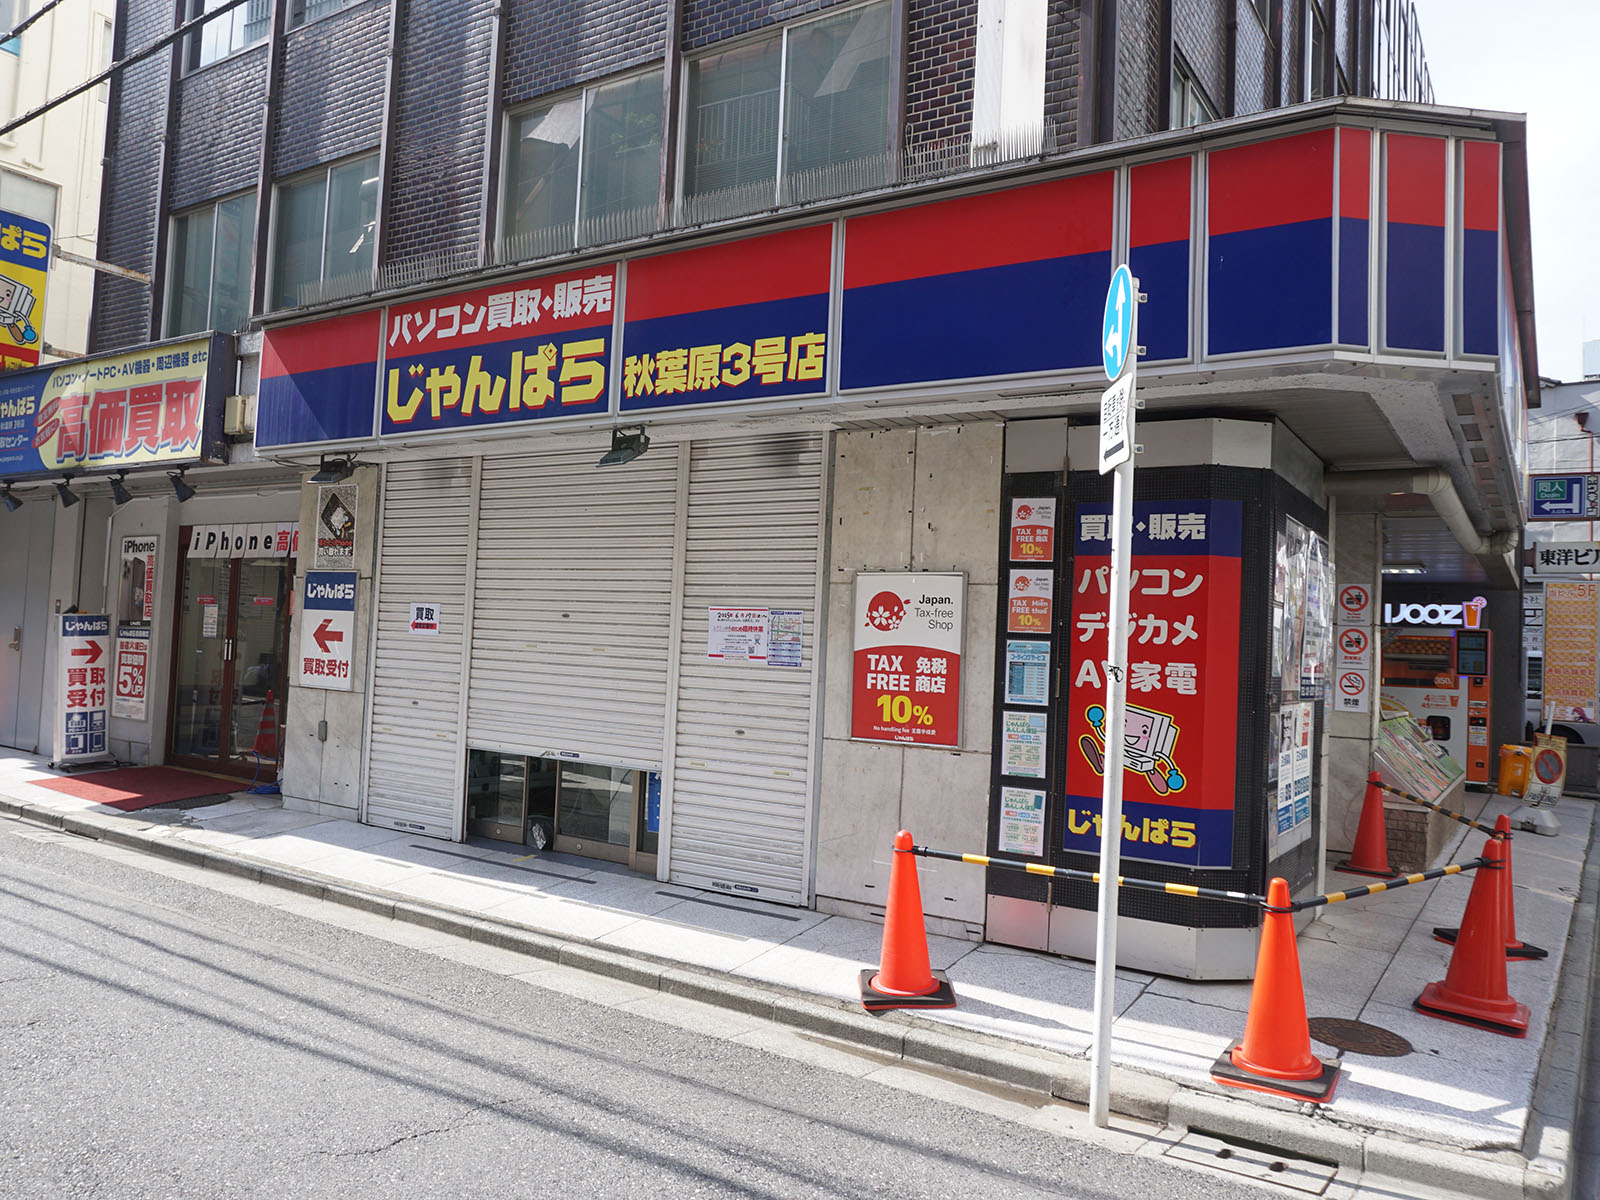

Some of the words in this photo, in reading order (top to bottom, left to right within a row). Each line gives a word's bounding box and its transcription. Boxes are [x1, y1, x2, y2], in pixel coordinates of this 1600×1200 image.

[192, 350, 208, 364] etc
[623, 332, 827, 397] 秋葉原3号店
[385, 337, 605, 423] じゃんぱら
[56, 378, 203, 464] 高価買取
[1016, 528, 1031, 536] TAX
[1015, 535, 1034, 543] FREE
[124, 540, 155, 553] iPhone
[1020, 543, 1044, 555] 10%
[306, 583, 354, 600] じゃんぱら
[918, 594, 954, 607] Japan.
[1012, 599, 1028, 607] TAX
[415, 607, 434, 620] 買取
[914, 607, 954, 621] Tax-free
[1011, 606, 1031, 614] FREE
[65, 620, 108, 632] じゃんぱら
[927, 619, 954, 632] Shop
[1018, 614, 1041, 626] 10%
[303, 658, 350, 679] 買取受付
[867, 654, 904, 673] TAX
[915, 656, 948, 675] 免税
[67, 667, 106, 687] 買取
[118, 666, 144, 695] 5%
[866, 673, 911, 692] FREE
[914, 675, 947, 694] 商店
[66, 688, 106, 708] 受付
[1343, 698, 1360, 706] 禁煙
[876, 693, 934, 726] 10%
[1006, 720, 1031, 728] じゃんぱら
[1005, 727, 1038, 735] あんしん保証
[1004, 796, 1030, 805] じゃんぱら
